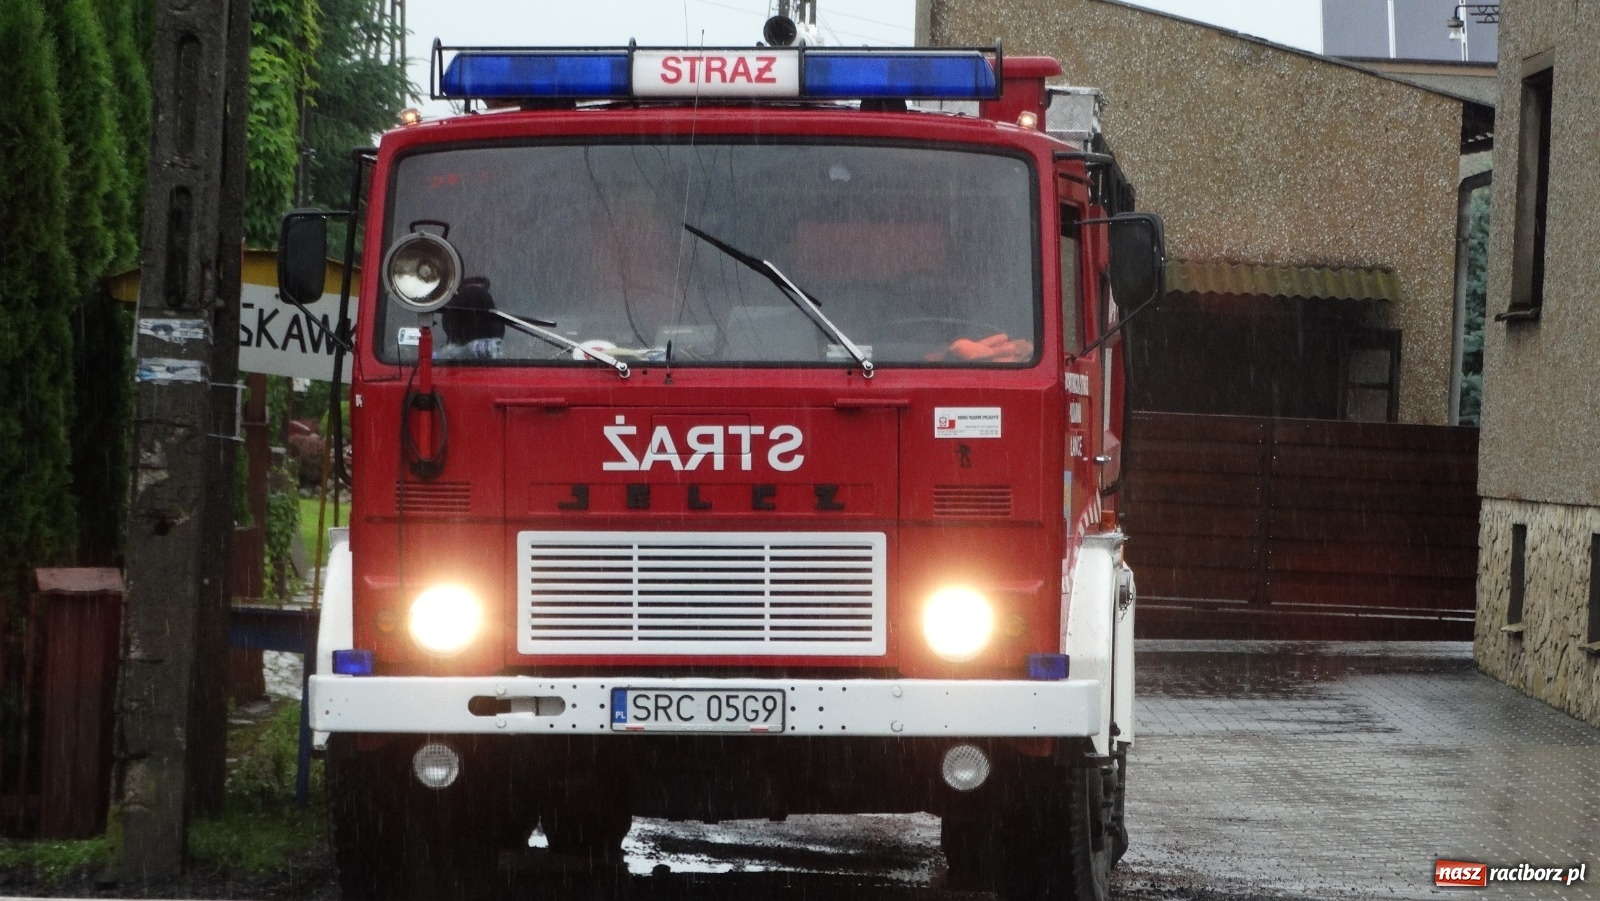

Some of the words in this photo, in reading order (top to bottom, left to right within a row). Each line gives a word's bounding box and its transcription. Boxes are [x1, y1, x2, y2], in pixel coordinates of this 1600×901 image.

[615, 710, 626, 720] PL
[632, 693, 695, 722] SRC
[706, 694, 778, 723] 05G9
